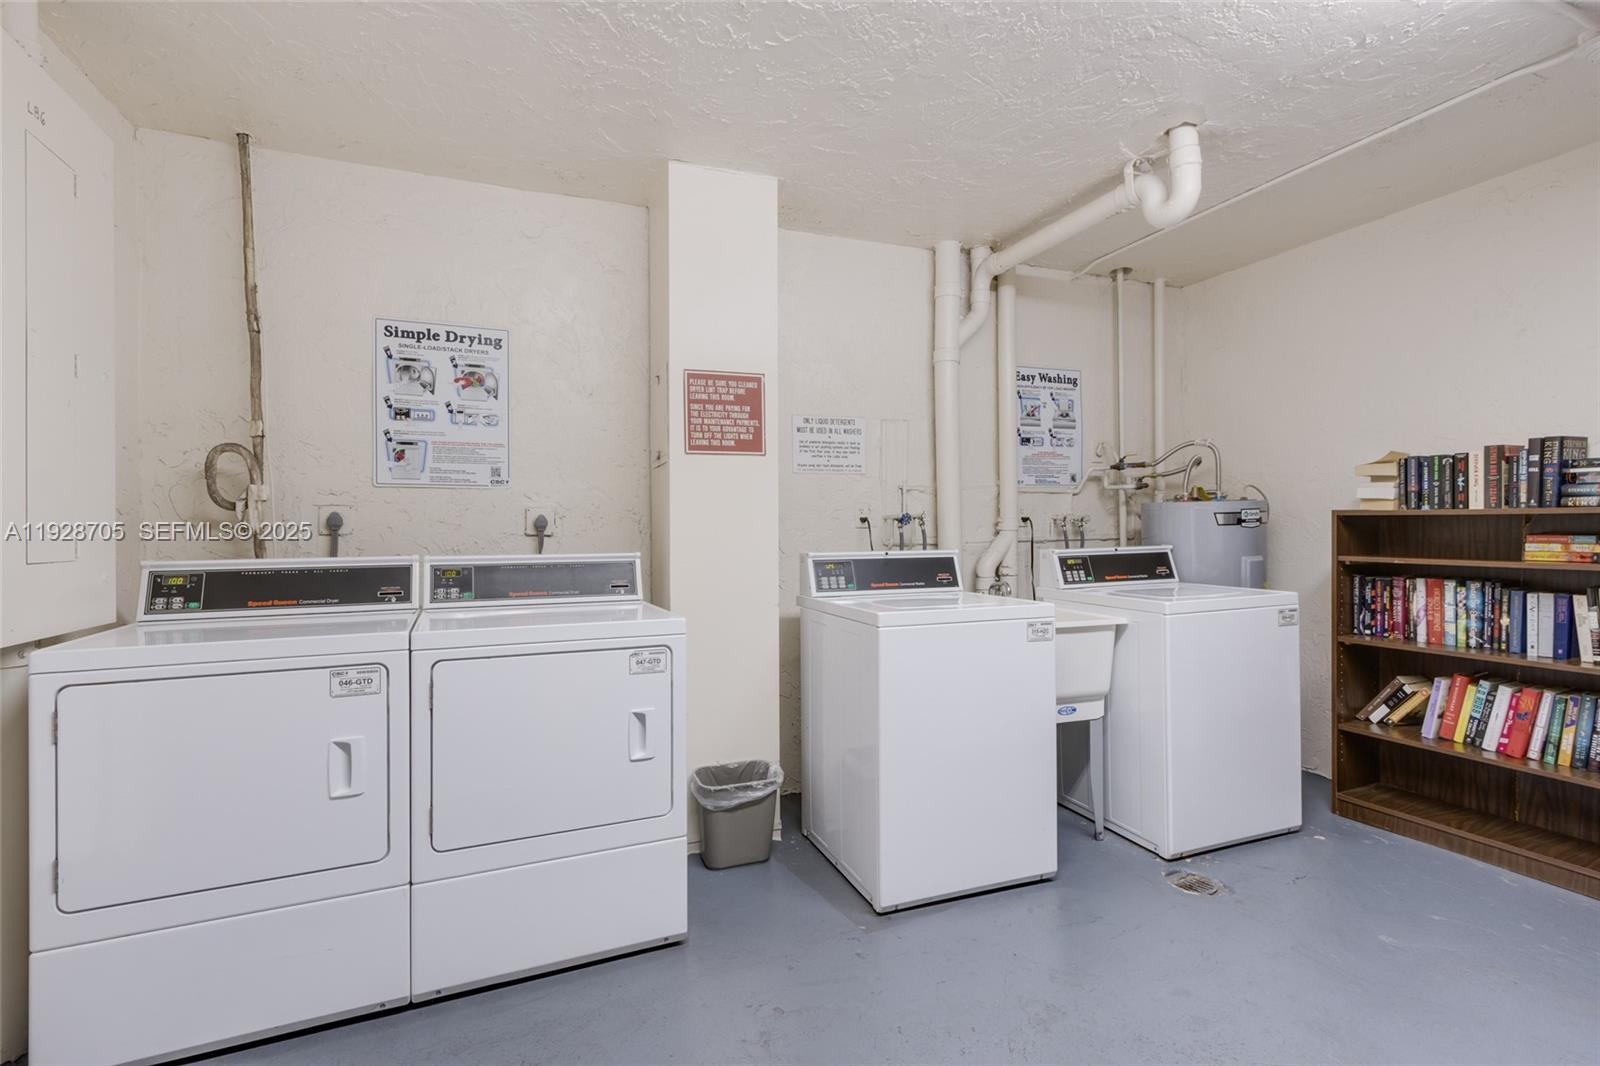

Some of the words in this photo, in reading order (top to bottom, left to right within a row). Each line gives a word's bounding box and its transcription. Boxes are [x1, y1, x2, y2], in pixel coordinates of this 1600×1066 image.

[383, 325, 441, 343] Simple
[445, 330, 503, 350] Drying
[464, 348, 489, 356] DRYERS
[689, 378, 706, 387] PLEASE
[707, 379, 713, 387] BE
[714, 380, 727, 388] SURE
[728, 380, 738, 388] YOU
[738, 381, 758, 389] CLEANED
[1038, 372, 1078, 387] Washing
[689, 386, 705, 394] DRYER
[705, 386, 716, 394] LINT
[689, 403, 704, 411] SINCE
[715, 404, 724, 412] ARE
[703, 418, 735, 426] MAINTENANCE
[802, 417, 814, 425] ONLY
[814, 417, 829, 425] LIQUID
[829, 418, 856, 426] DETERGENTS
[809, 426, 815, 434] BE
[843, 428, 863, 436] WASHERS
[704, 432, 712, 440] OFF
[1544, 440, 1553, 464] KING
[1562, 448, 1586, 460] KING
[338, 677, 373, 686] 046-GTD
